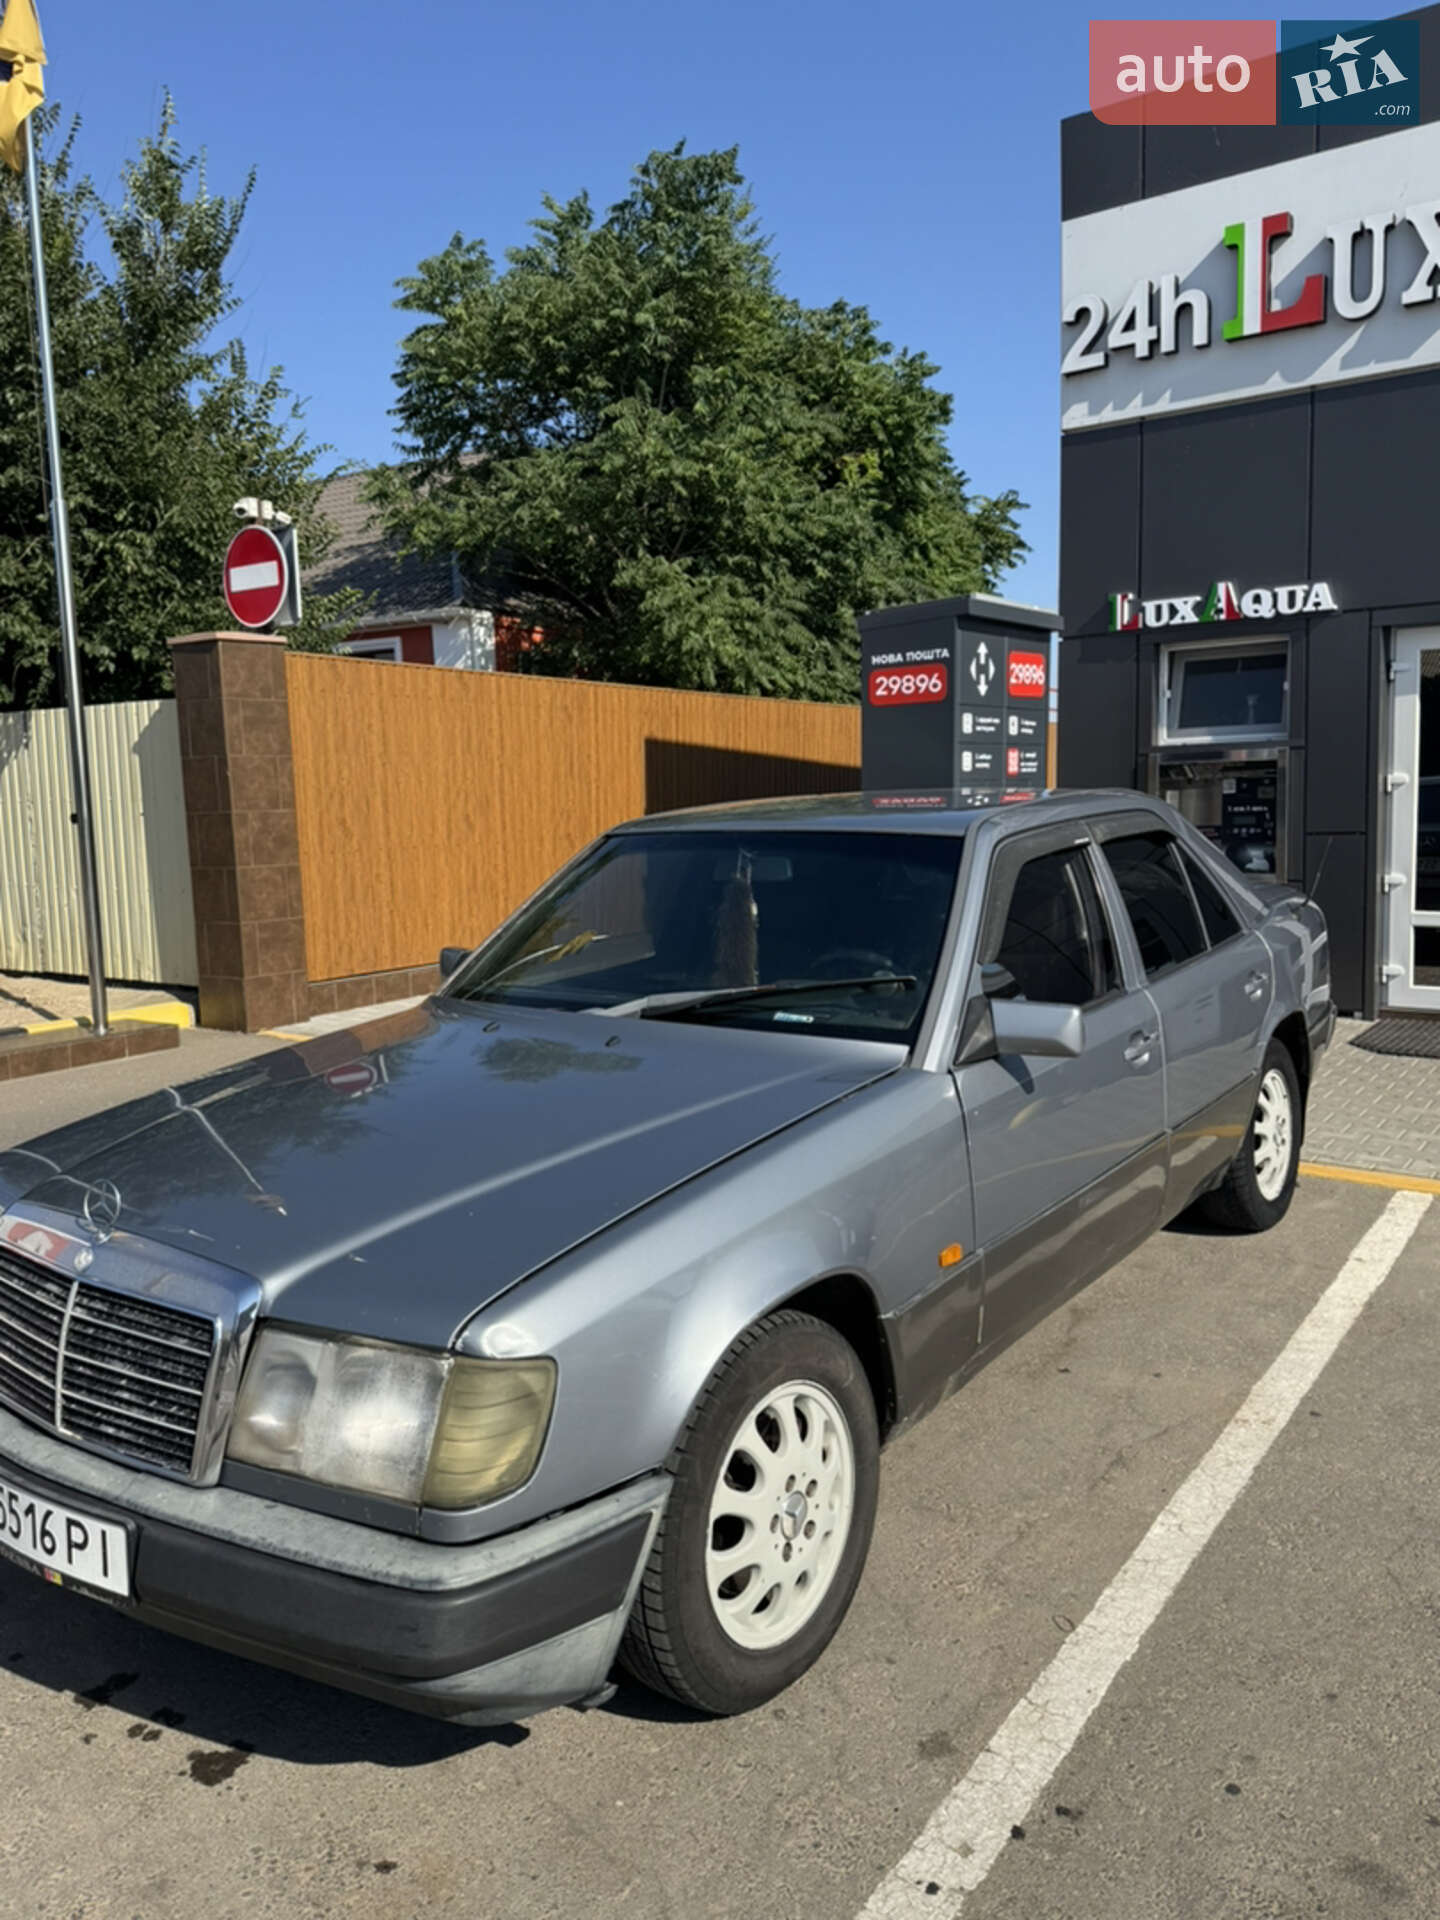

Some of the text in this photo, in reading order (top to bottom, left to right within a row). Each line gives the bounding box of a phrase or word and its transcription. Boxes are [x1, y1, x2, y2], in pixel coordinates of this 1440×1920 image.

[1061, 273, 1212, 377] 24h
[871, 648, 950, 666] НОВА ПОШТА
[875, 672, 942, 696] 29896
[1009, 662, 1046, 685] 29896
